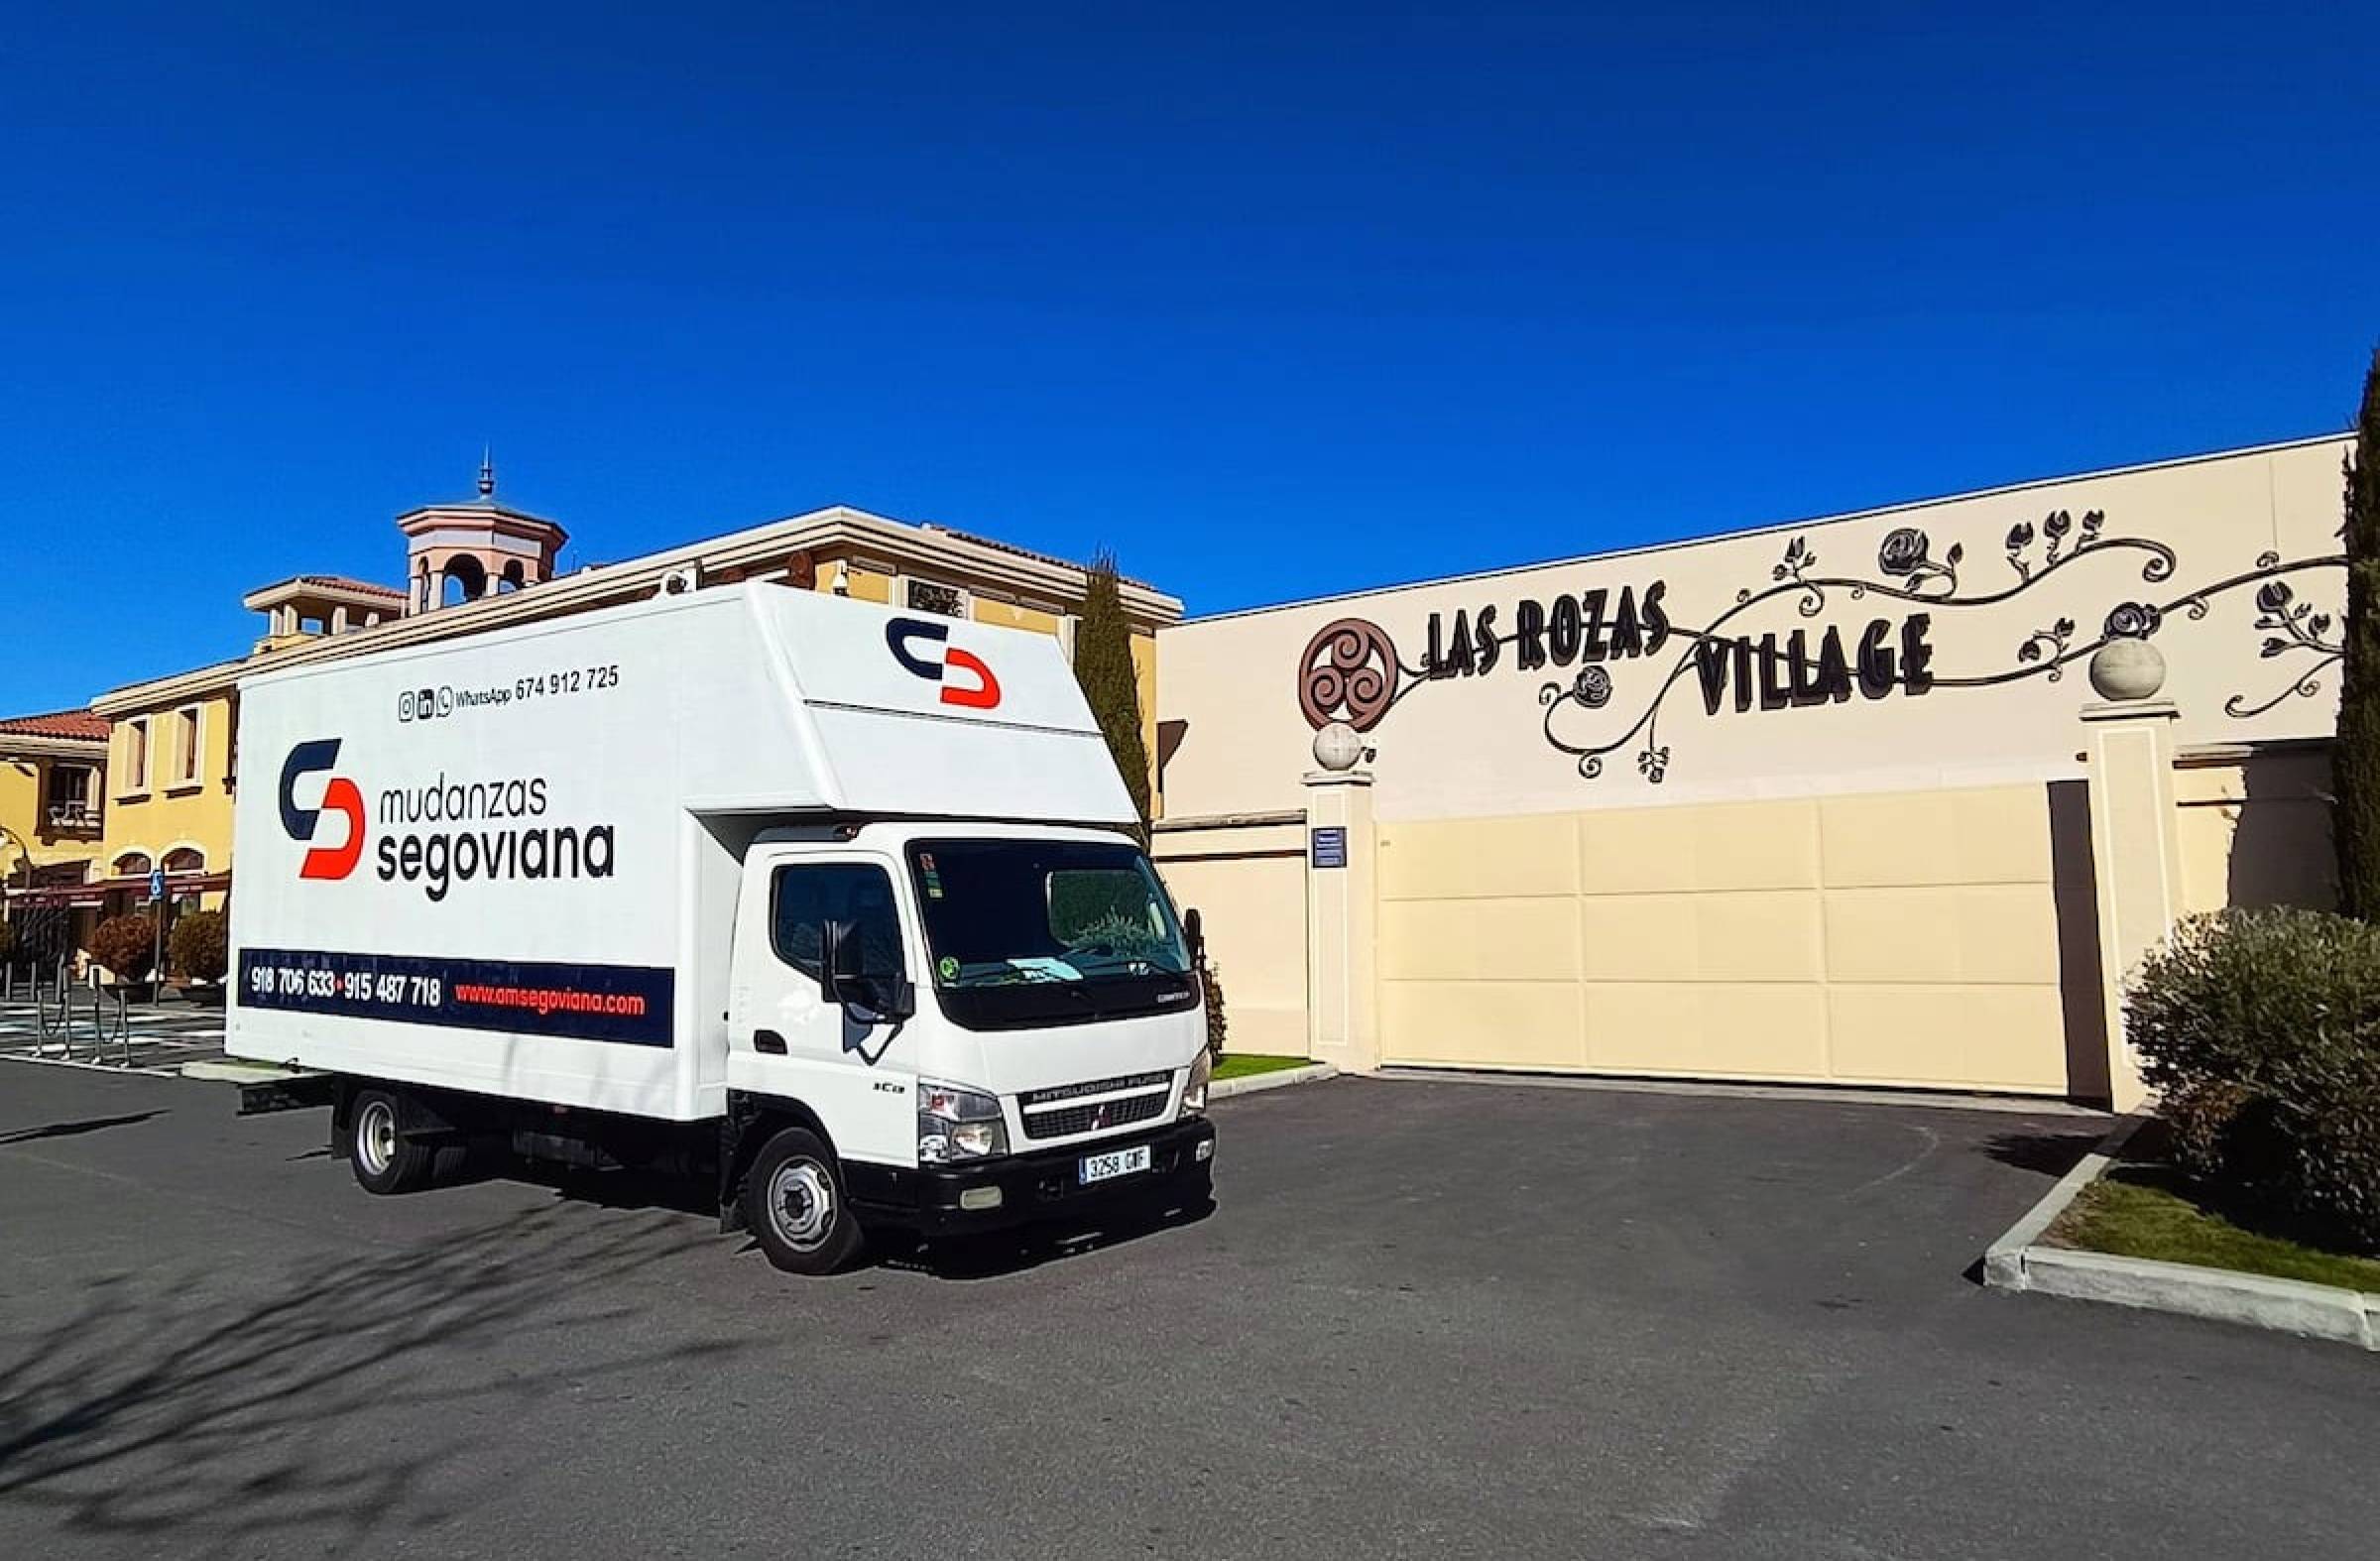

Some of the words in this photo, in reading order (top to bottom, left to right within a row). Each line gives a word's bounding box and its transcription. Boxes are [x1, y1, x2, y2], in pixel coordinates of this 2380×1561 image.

[1428, 604, 1499, 681] LAS
[1517, 579, 1669, 671] ROZAS
[516, 676, 544, 700] 674
[549, 670, 581, 694] 912
[586, 664, 620, 690] 725
[1696, 612, 1933, 715] VILLAGE
[380, 772, 547, 824] mudanzas
[377, 825, 615, 902] segoviana
[278, 968, 304, 995] 706
[307, 970, 335, 998] 633
[344, 972, 372, 1002] 915
[376, 974, 407, 1004] 487
[411, 976, 441, 1008] 718
